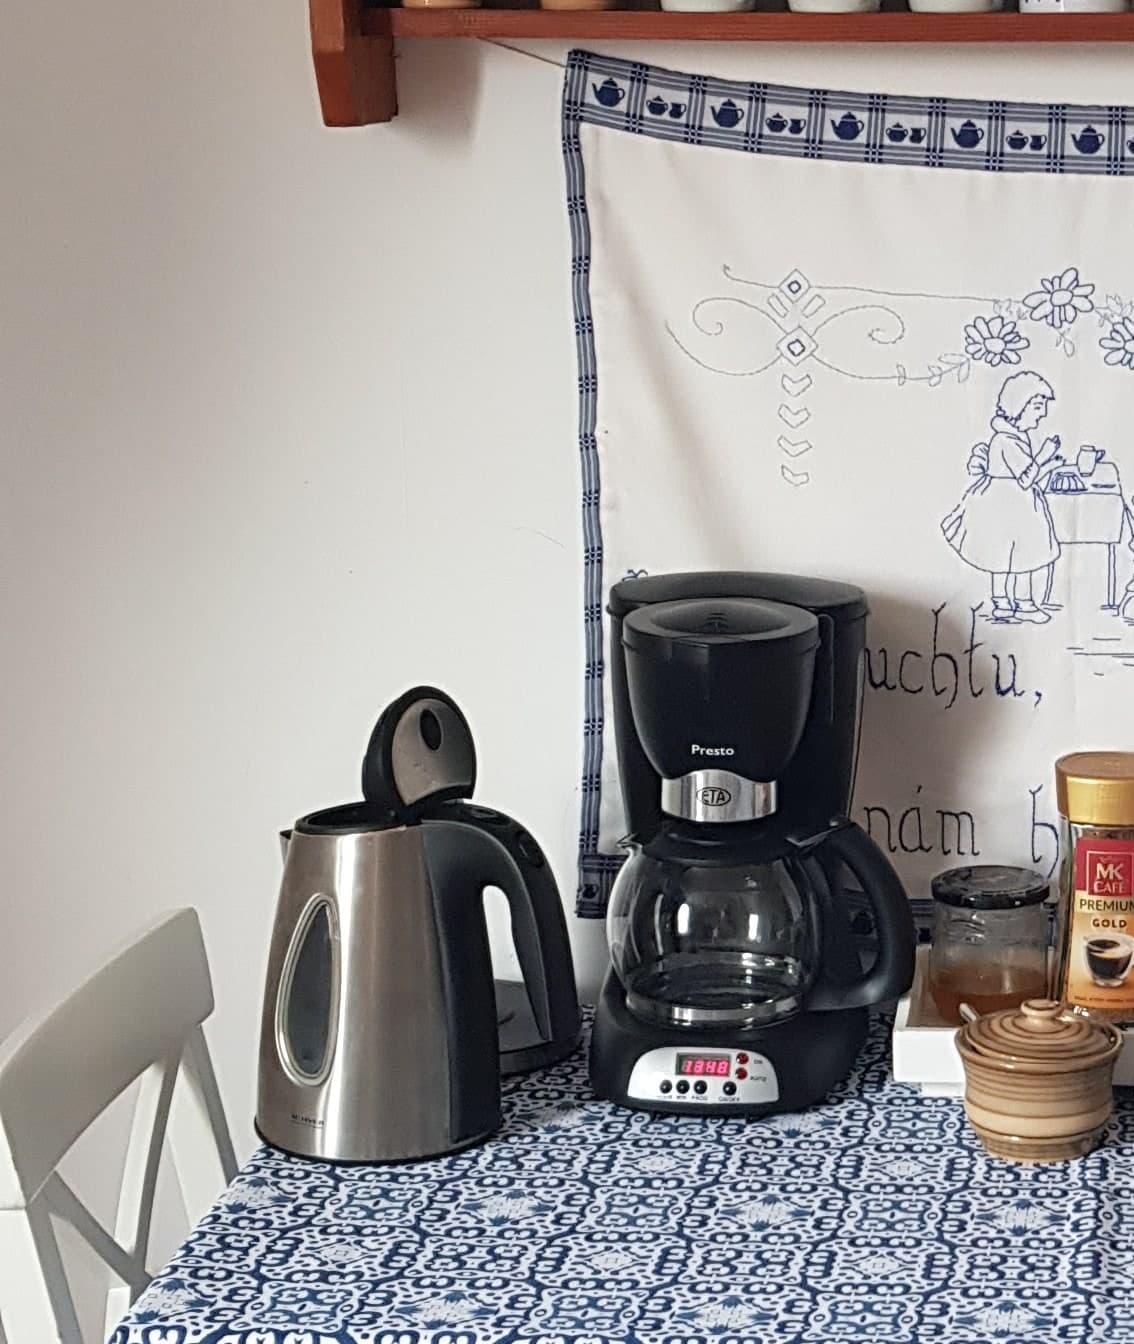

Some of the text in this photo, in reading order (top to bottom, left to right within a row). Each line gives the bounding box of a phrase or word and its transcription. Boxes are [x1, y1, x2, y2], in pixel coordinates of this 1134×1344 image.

[864, 601, 1043, 710] uchtu,
[690, 743, 735, 757] Presto
[701, 789, 726, 805] ETA
[1095, 862, 1125, 881] MK
[1091, 917, 1128, 929] GOLD
